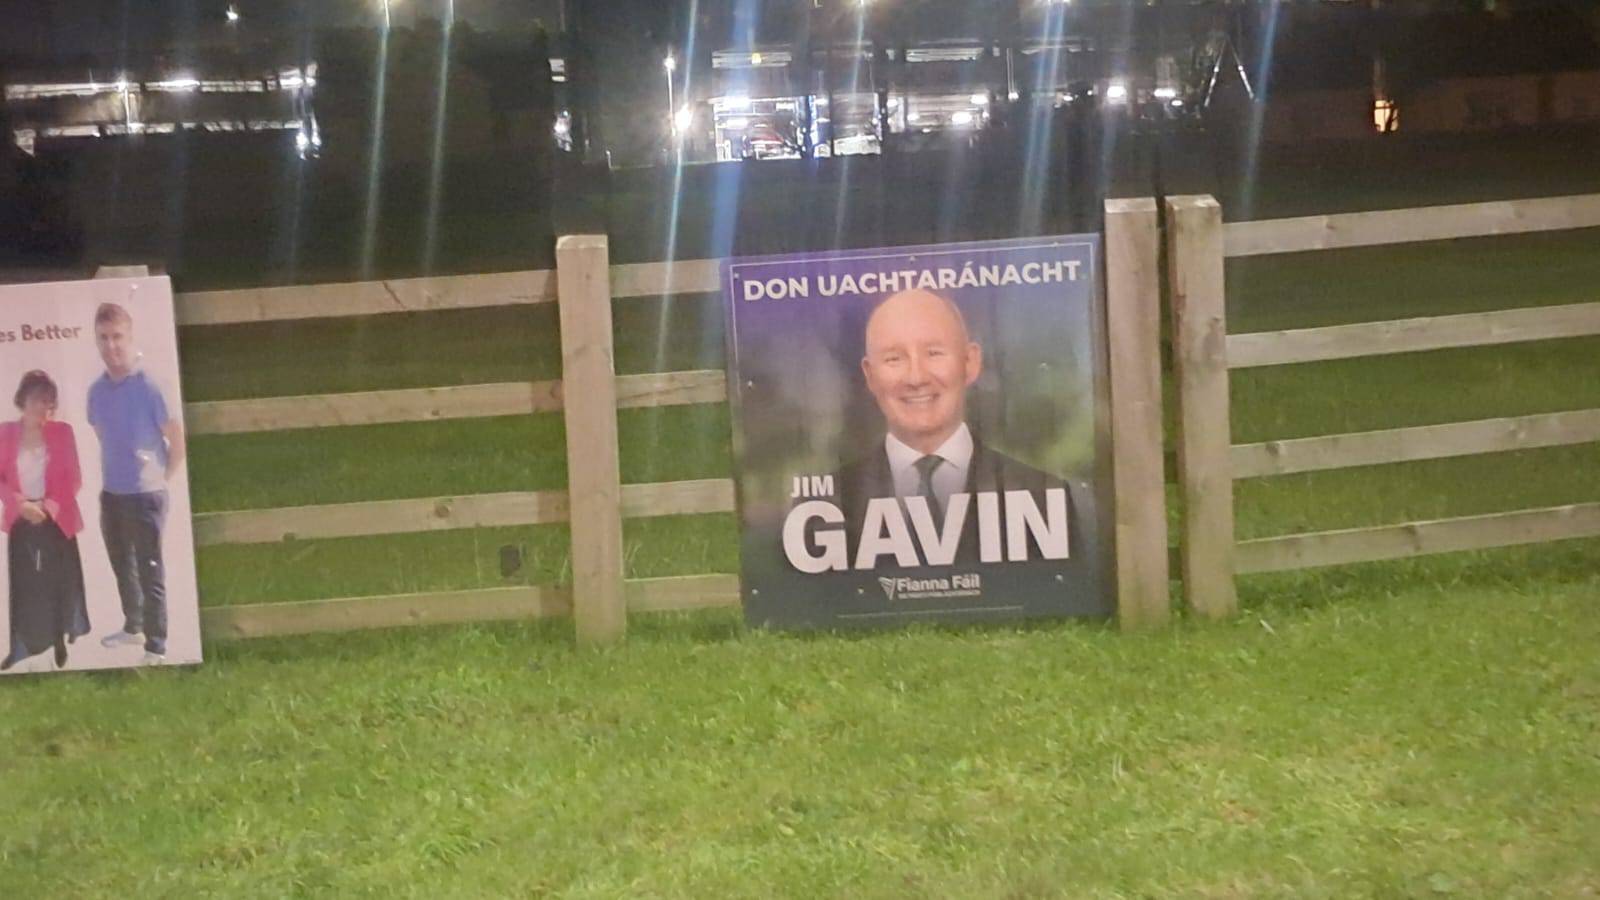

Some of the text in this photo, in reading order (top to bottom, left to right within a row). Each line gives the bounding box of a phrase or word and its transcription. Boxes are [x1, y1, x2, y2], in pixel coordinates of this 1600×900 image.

[743, 259, 1081, 302] DON UACHTARÁNACHT
[21, 323, 81, 341] Better
[790, 475, 834, 498] JIM
[782, 487, 1070, 574] GAVIN
[896, 573, 981, 592] Fianna Fáil
